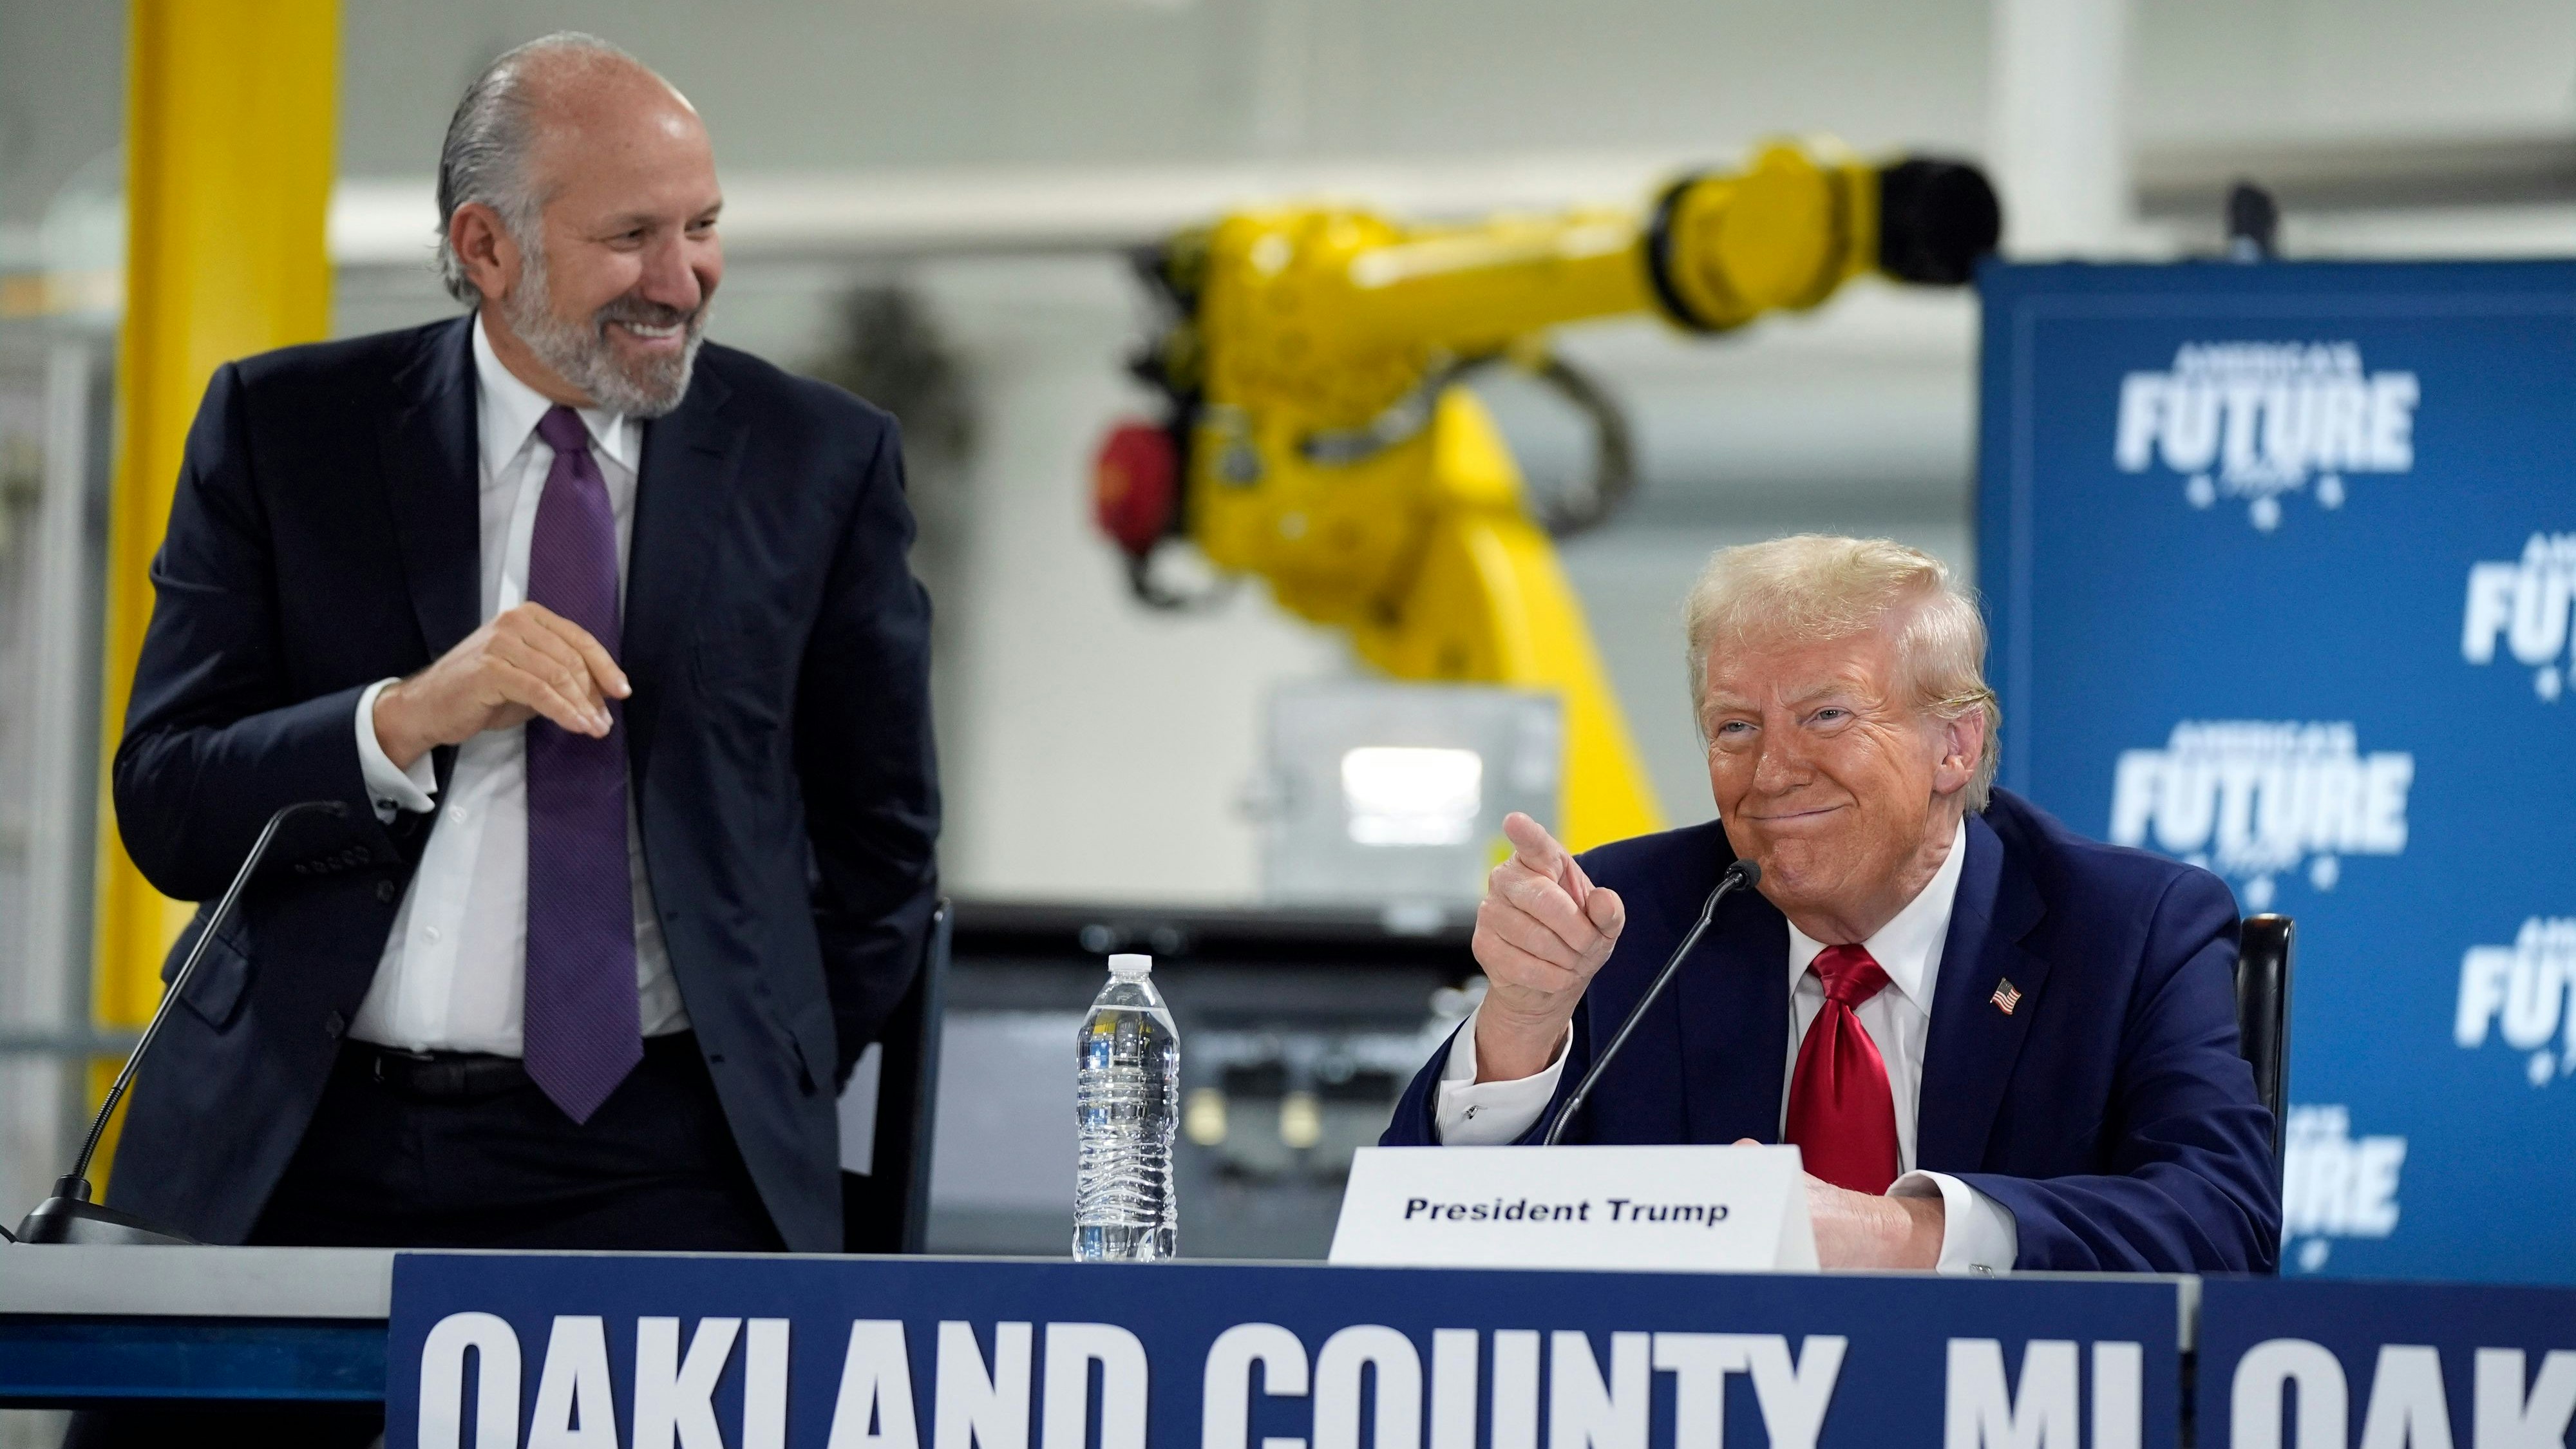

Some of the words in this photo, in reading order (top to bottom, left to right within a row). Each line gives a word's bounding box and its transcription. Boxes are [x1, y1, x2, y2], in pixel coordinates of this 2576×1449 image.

[2115, 372, 2420, 472] FUTURE
[2461, 562, 2576, 665] FU
[2110, 750, 2415, 855] FUTURE
[1404, 1198, 1591, 1221] President
[1607, 1199, 1730, 1227] Trump
[417, 1311, 1149, 1449] OAKLAND
